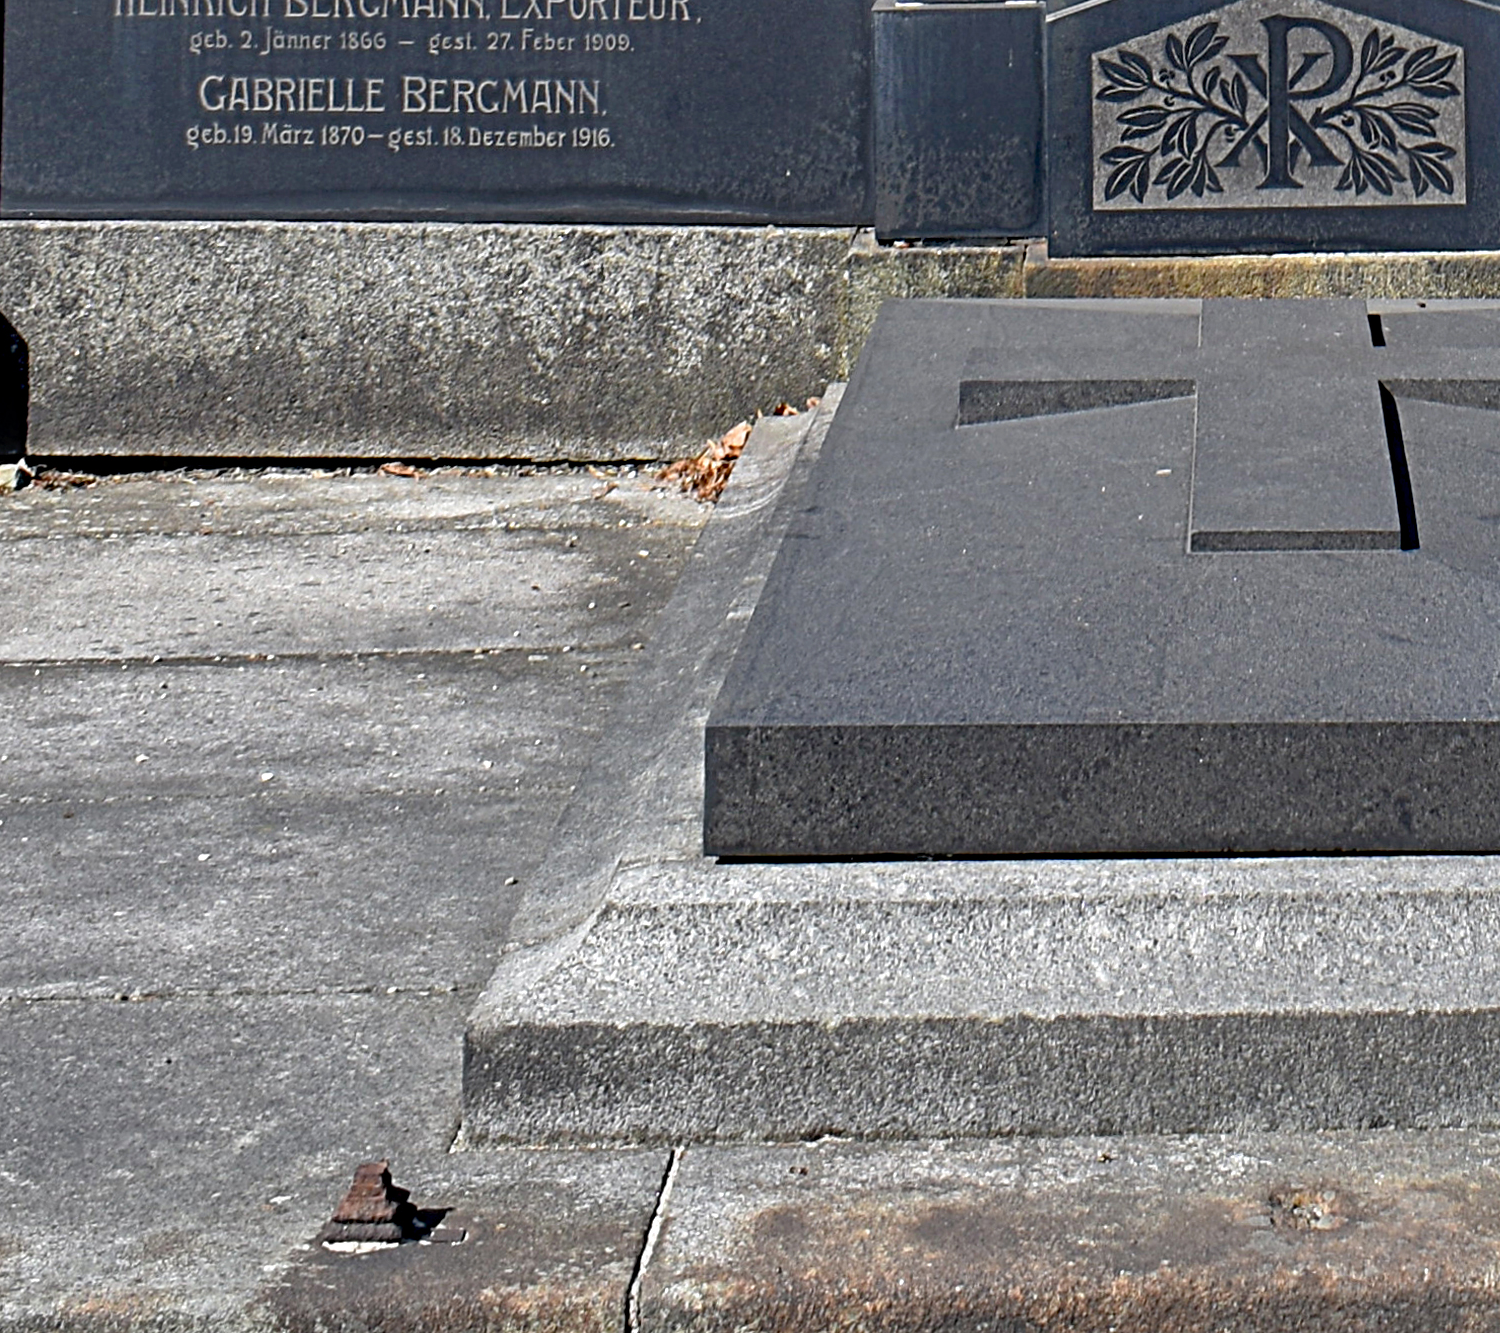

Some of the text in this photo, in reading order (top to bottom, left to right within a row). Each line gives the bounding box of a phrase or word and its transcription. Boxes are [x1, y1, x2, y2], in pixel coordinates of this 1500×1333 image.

[189, 29, 233, 56] geb.
[259, 26, 332, 56] Jänner
[340, 31, 387, 51] 1866
[521, 27, 576, 52] Feber
[584, 32, 636, 53] 1909.
[199, 74, 386, 113] GABRIELLE
[260, 121, 315, 146] März
[572, 126, 616, 148] 1916.
